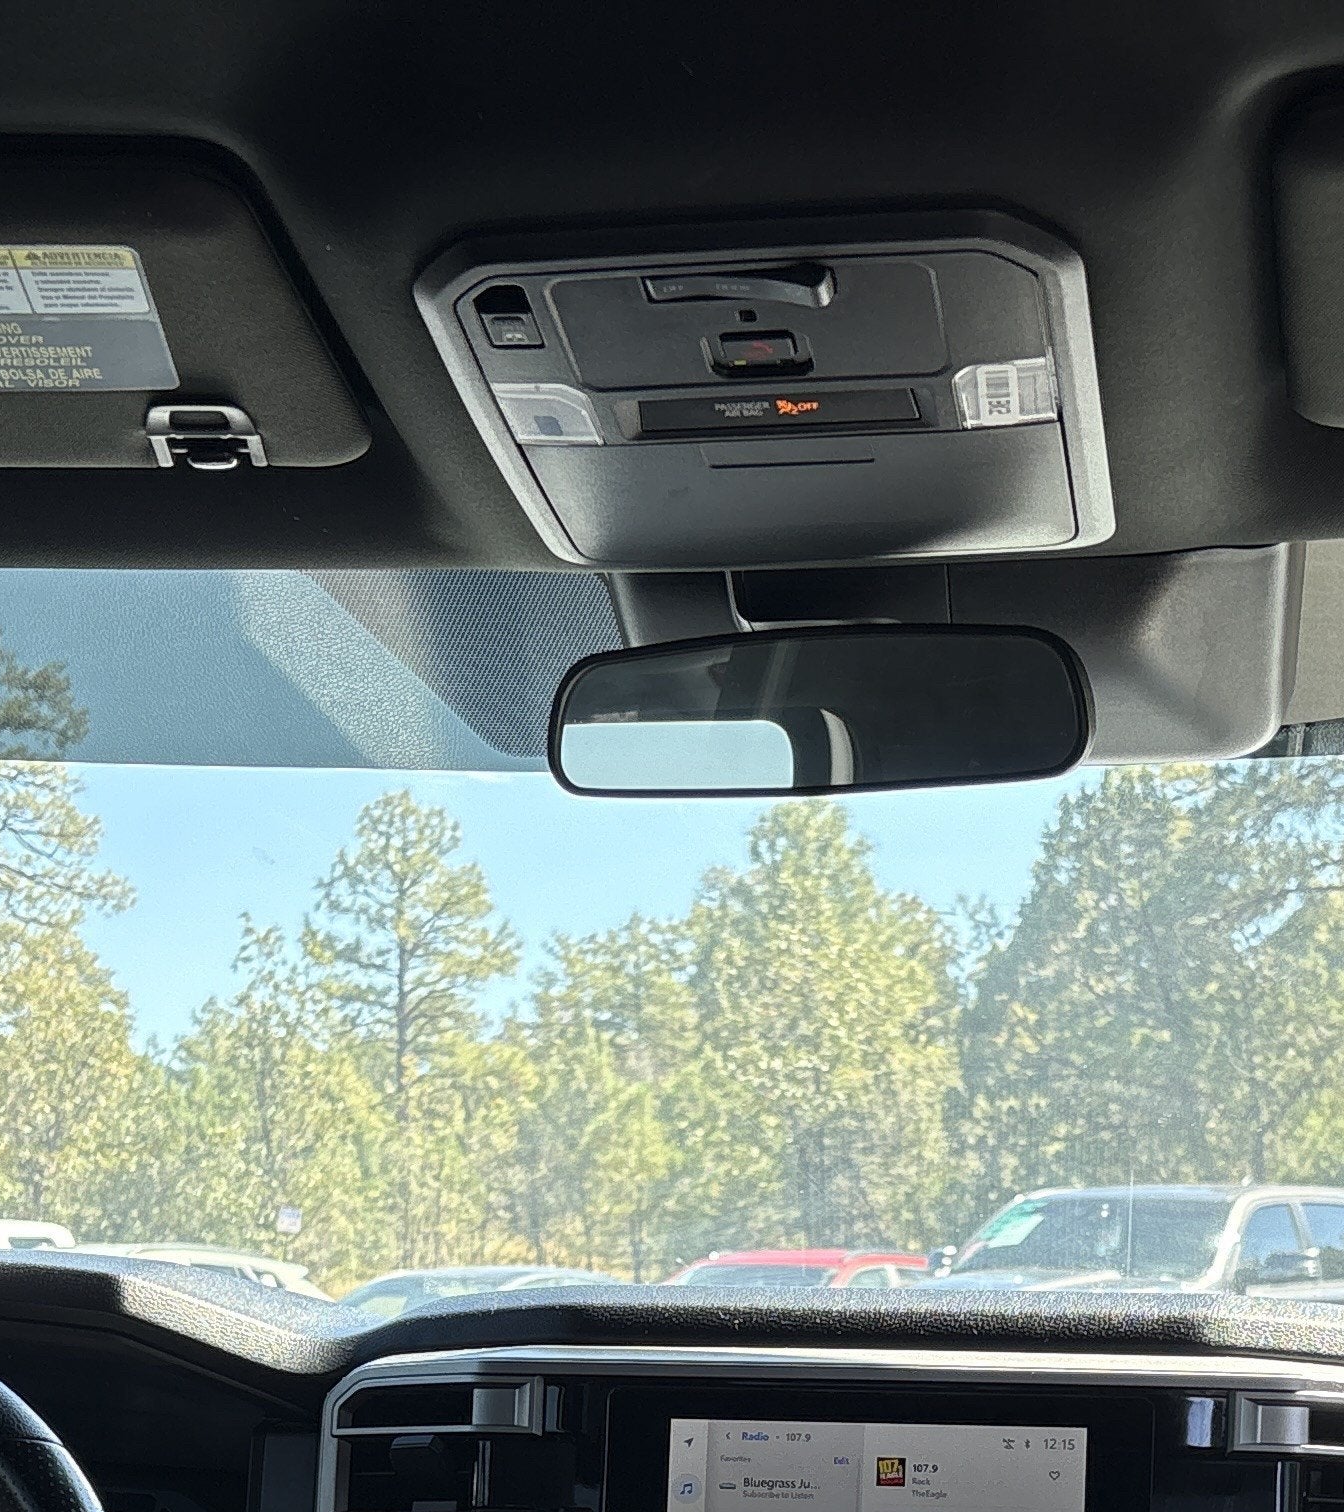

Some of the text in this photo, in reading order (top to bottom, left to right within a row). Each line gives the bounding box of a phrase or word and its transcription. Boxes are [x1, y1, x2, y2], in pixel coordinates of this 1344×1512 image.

[0, 369, 44, 380] BOLSA
[50, 369, 68, 380] DE
[71, 368, 103, 380] AIRE
[27, 379, 81, 388] VISOR
[742, 1431, 812, 1443] Radio 107.9
[1043, 1438, 1076, 1451] 12:15
[912, 1463, 939, 1474] 107.9
[743, 1477, 797, 1491] Bluegrass
[742, 1489, 780, 1499] Subscribe
[781, 1490, 790, 1498] to
